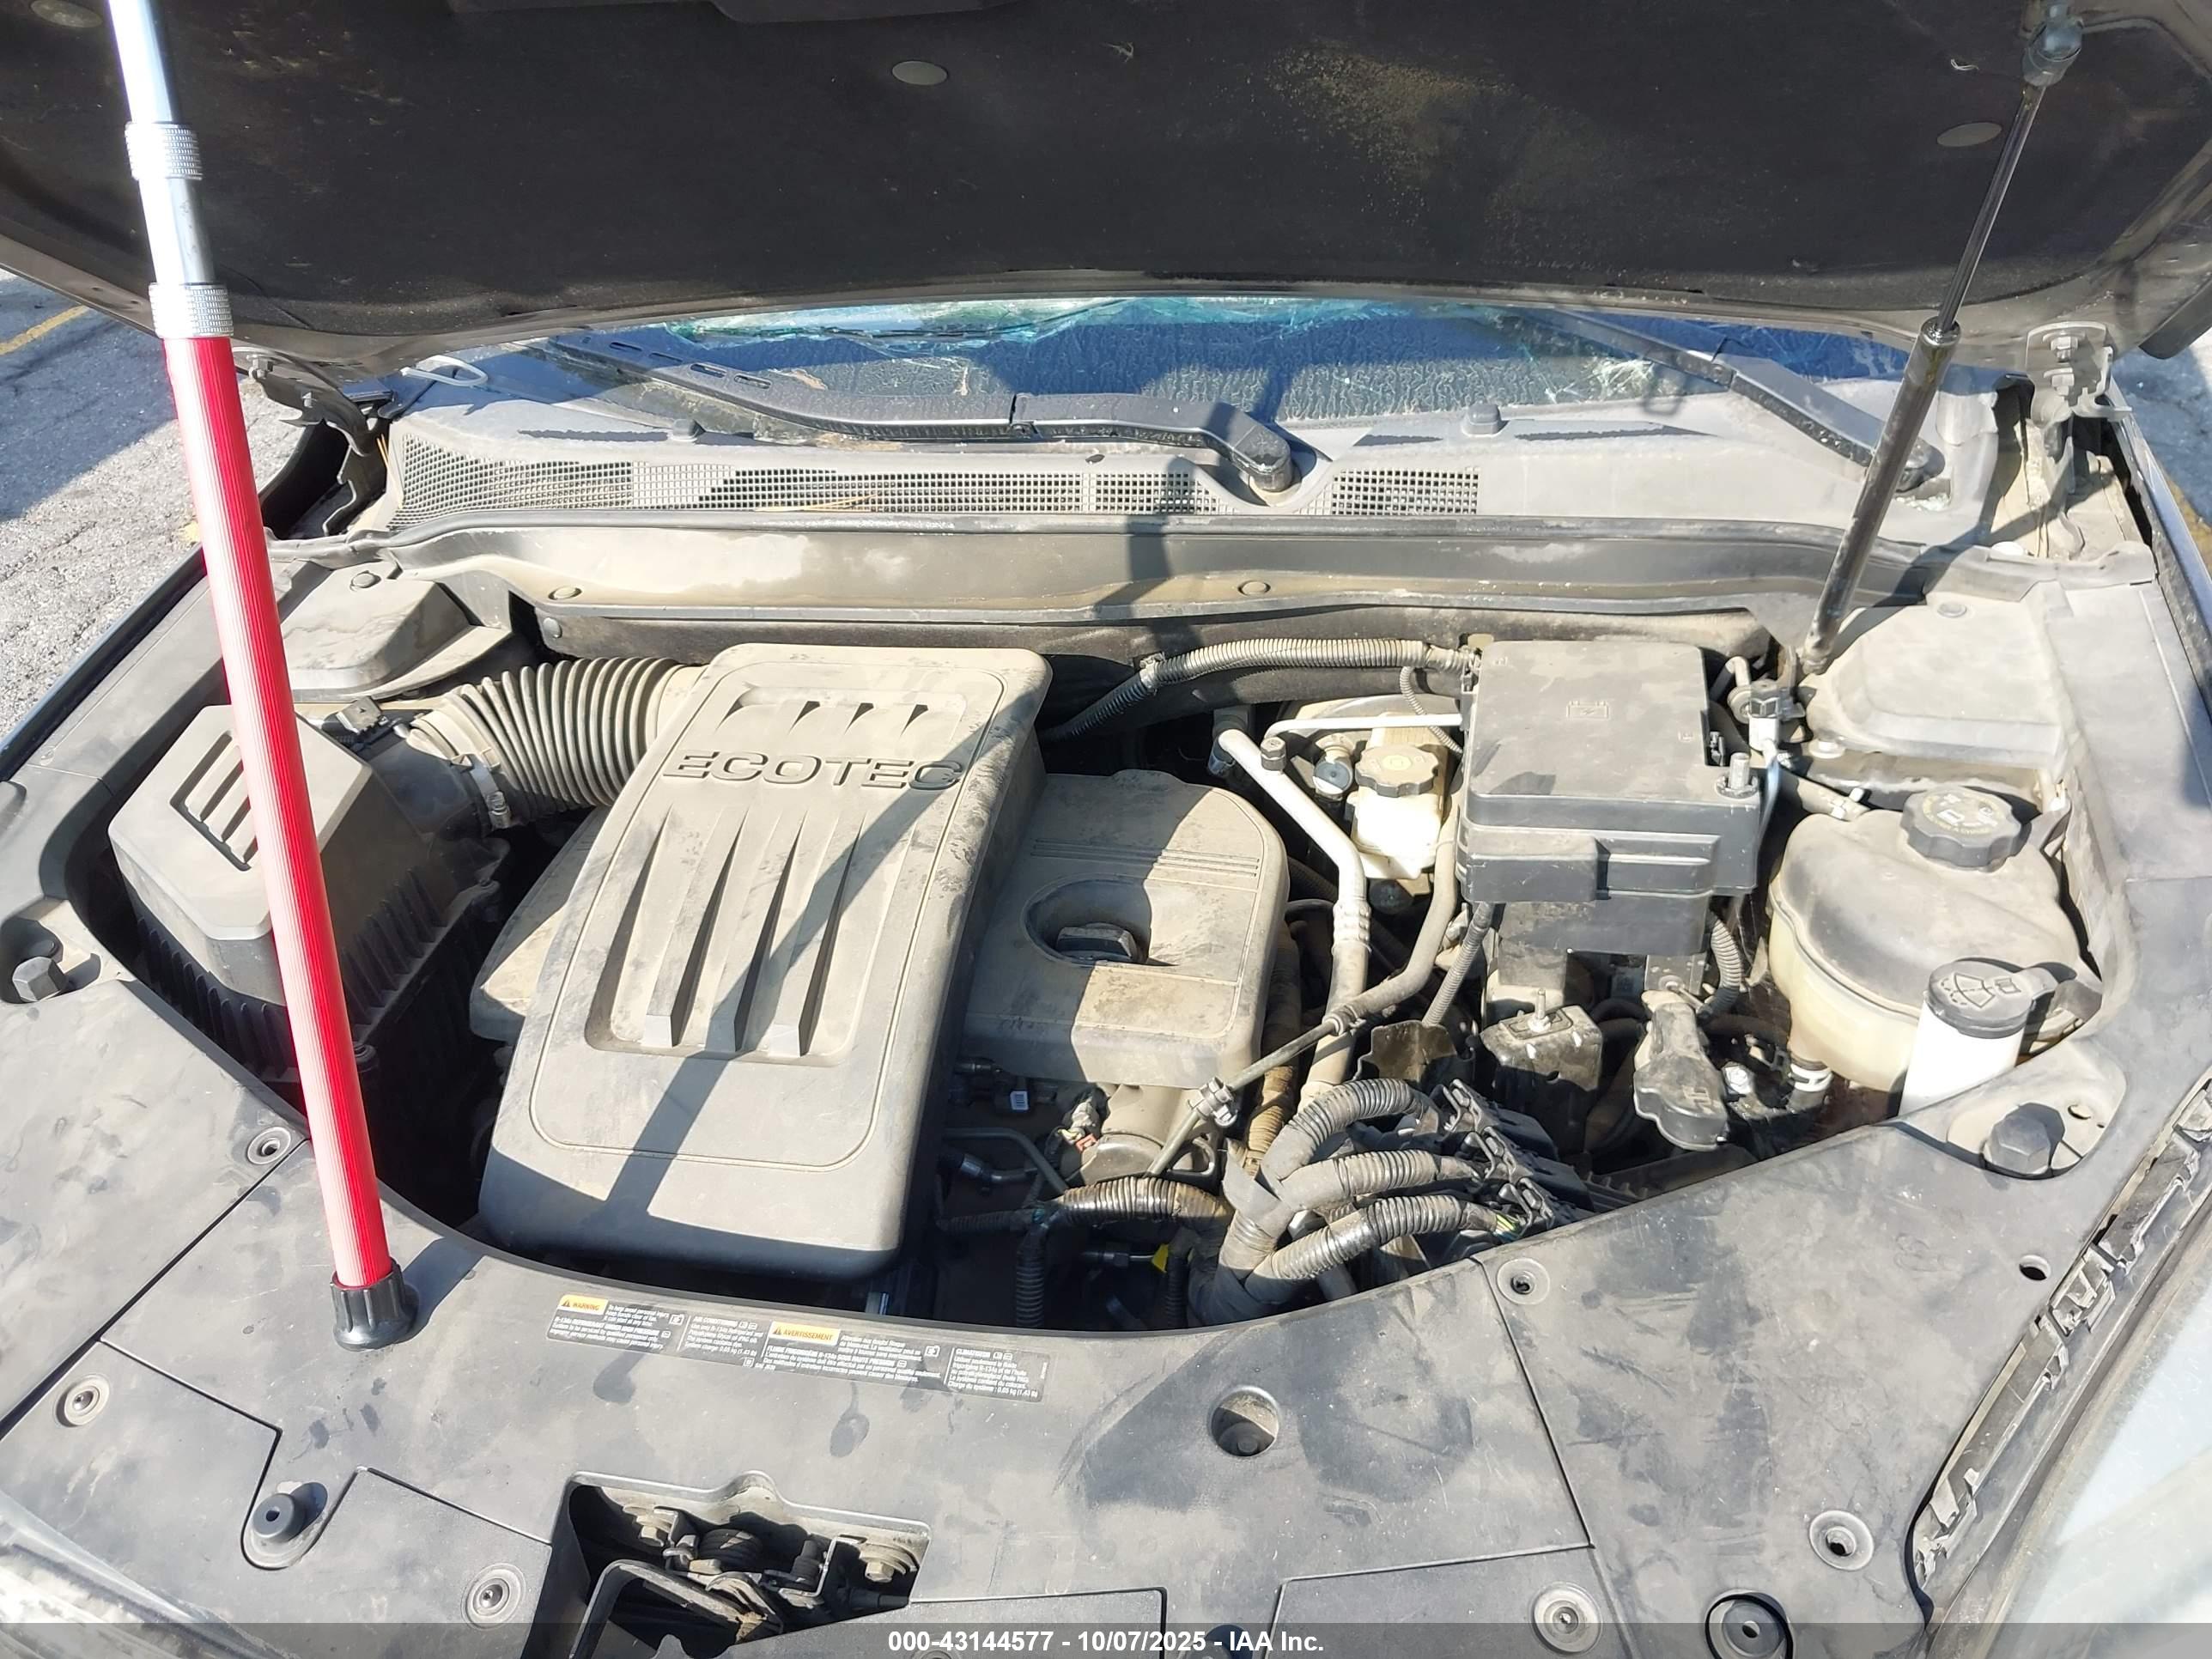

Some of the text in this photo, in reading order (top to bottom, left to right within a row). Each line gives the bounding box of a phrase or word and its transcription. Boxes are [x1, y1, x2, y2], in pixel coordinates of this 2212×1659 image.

[663, 750, 965, 790] ECOTEC
[573, 1302, 599, 1310] WARNING
[783, 1330, 833, 1340] AVERTISSEMENT
